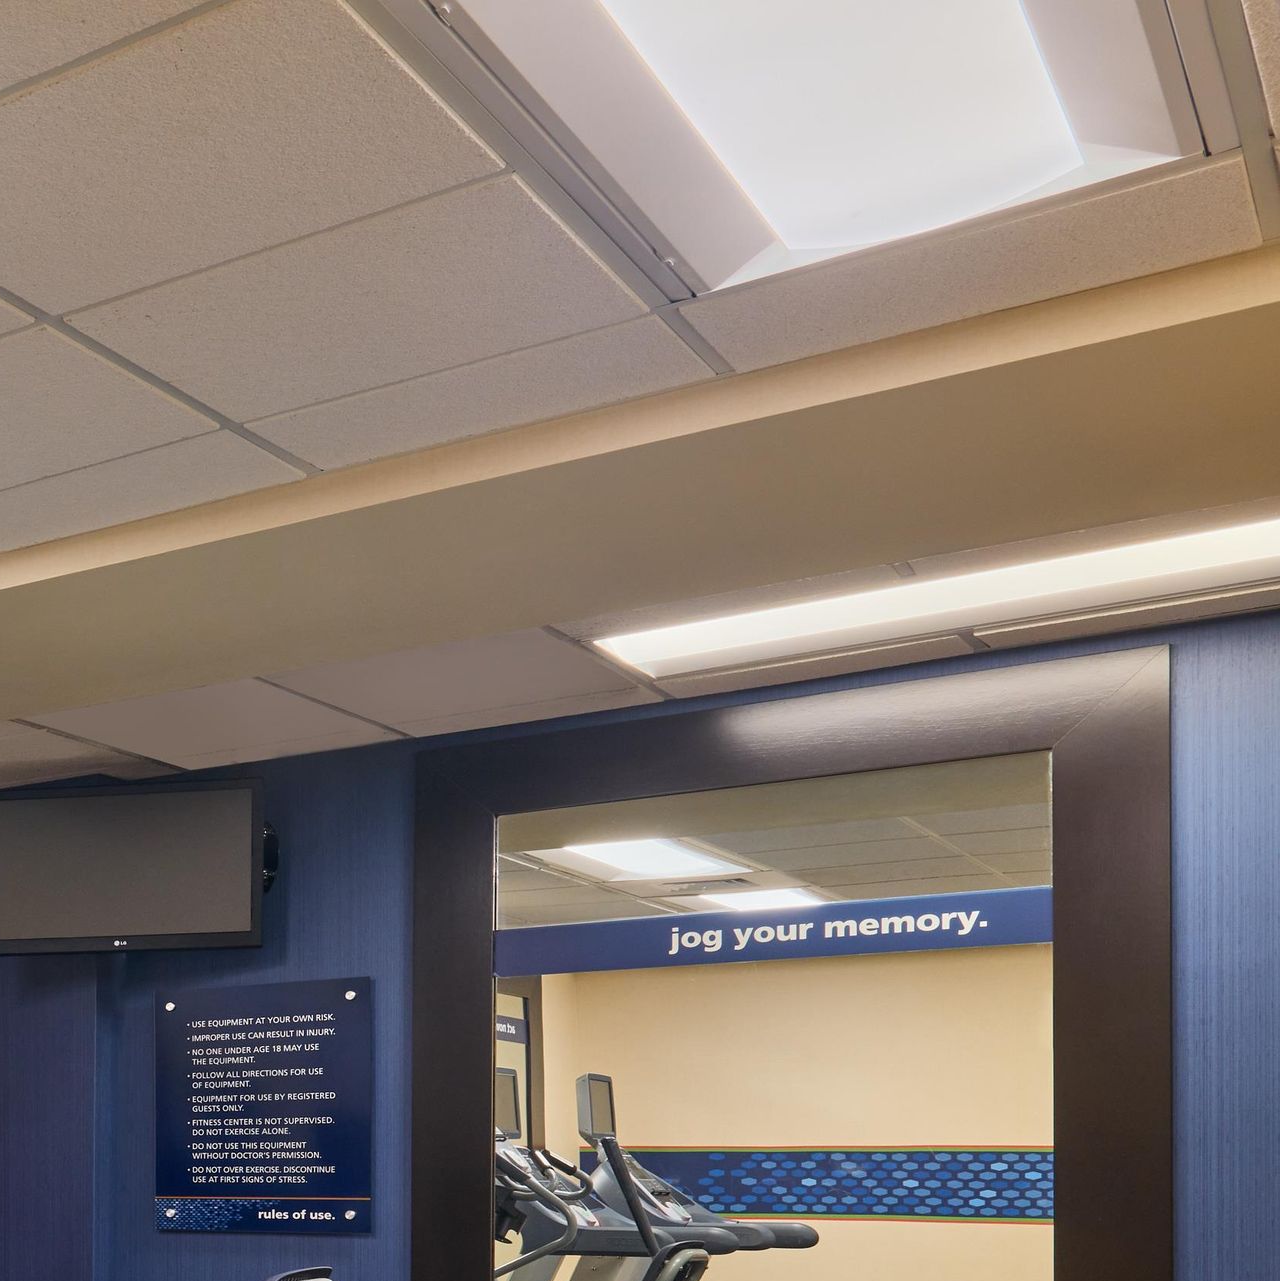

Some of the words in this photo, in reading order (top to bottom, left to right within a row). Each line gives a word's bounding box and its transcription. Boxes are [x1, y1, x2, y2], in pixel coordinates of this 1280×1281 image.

[669, 927, 722, 954] jog
[733, 923, 813, 950] your
[825, 911, 987, 938] memory.
[191, 1020, 206, 1029] USE
[207, 1017, 254, 1028] EQUIPMENT
[254, 1016, 266, 1025] AT
[267, 1015, 291, 1024] YOUR
[292, 1014, 314, 1023] OWN
[315, 1013, 336, 1022] RISK.
[191, 1033, 231, 1042] IMPROPER
[231, 1032, 247, 1040] USE
[247, 1031, 265, 1040] CAN
[266, 1029, 295, 1039] RESULT
[295, 1029, 305, 1037] IN
[306, 1027, 336, 1037] INJURY.
[191, 1048, 205, 1056] NO
[205, 1047, 223, 1056] ONE
[224, 1046, 252, 1055] UNDER
[252, 1045, 270, 1054] AGE
[272, 1044, 282, 1053] 18
[283, 1044, 303, 1052] MAY
[304, 1042, 320, 1052] USE
[191, 1057, 207, 1066] THE
[208, 1055, 256, 1066] EQUIPMENT.
[191, 1071, 225, 1080] FOLLOW
[225, 1070, 241, 1078] ALL
[242, 1068, 289, 1078] DIRECTIONS
[290, 1068, 307, 1076] FOR
[308, 1067, 324, 1076] USE
[191, 1081, 203, 1089] OF
[204, 1080, 252, 1090] EQUIPMENT.
[192, 1094, 238, 1104] EQUIPMENT
[239, 1094, 256, 1102] FOR
[257, 1093, 273, 1102] USE
[274, 1093, 286, 1101] BY
[287, 1091, 336, 1101] REGISTERED
[191, 1104, 221, 1113] GUESTS
[222, 1104, 245, 1112] ONLY.
[192, 1118, 222, 1127] FITNESS
[223, 1118, 254, 1126] CENTER
[255, 1117, 263, 1126] IS
[264, 1117, 283, 1125] NOT
[283, 1116, 335, 1125] SUPERVISED.
[192, 1128, 205, 1136] DO
[206, 1128, 224, 1136] NOT
[224, 1127, 260, 1136] EXERCISE
[261, 1127, 291, 1135] ALONE.
[192, 1142, 205, 1150] DO
[206, 1142, 223, 1150] NOT
[224, 1142, 239, 1150] USE
[240, 1142, 258, 1150] THIS
[259, 1141, 307, 1150] EQUIPMENT
[191, 1152, 230, 1160] WITHOUT
[230, 1151, 271, 1160] DOCTOR'S
[271, 1151, 322, 1159] PERMISSION.
[192, 1166, 205, 1174] DO
[205, 1166, 222, 1174] NOT
[222, 1166, 244, 1174] OVER
[245, 1165, 282, 1174] EXERCISE.
[283, 1165, 336, 1174] DISCONTINUE
[192, 1175, 207, 1183] USE
[208, 1175, 219, 1183] AT
[219, 1175, 240, 1184] FIRST
[241, 1175, 264, 1184] SIGNS
[265, 1175, 277, 1184] OF
[278, 1175, 308, 1184] STRESS.
[258, 1208, 289, 1220] rules
[292, 1209, 307, 1220] of
[309, 1212, 336, 1220] use.
